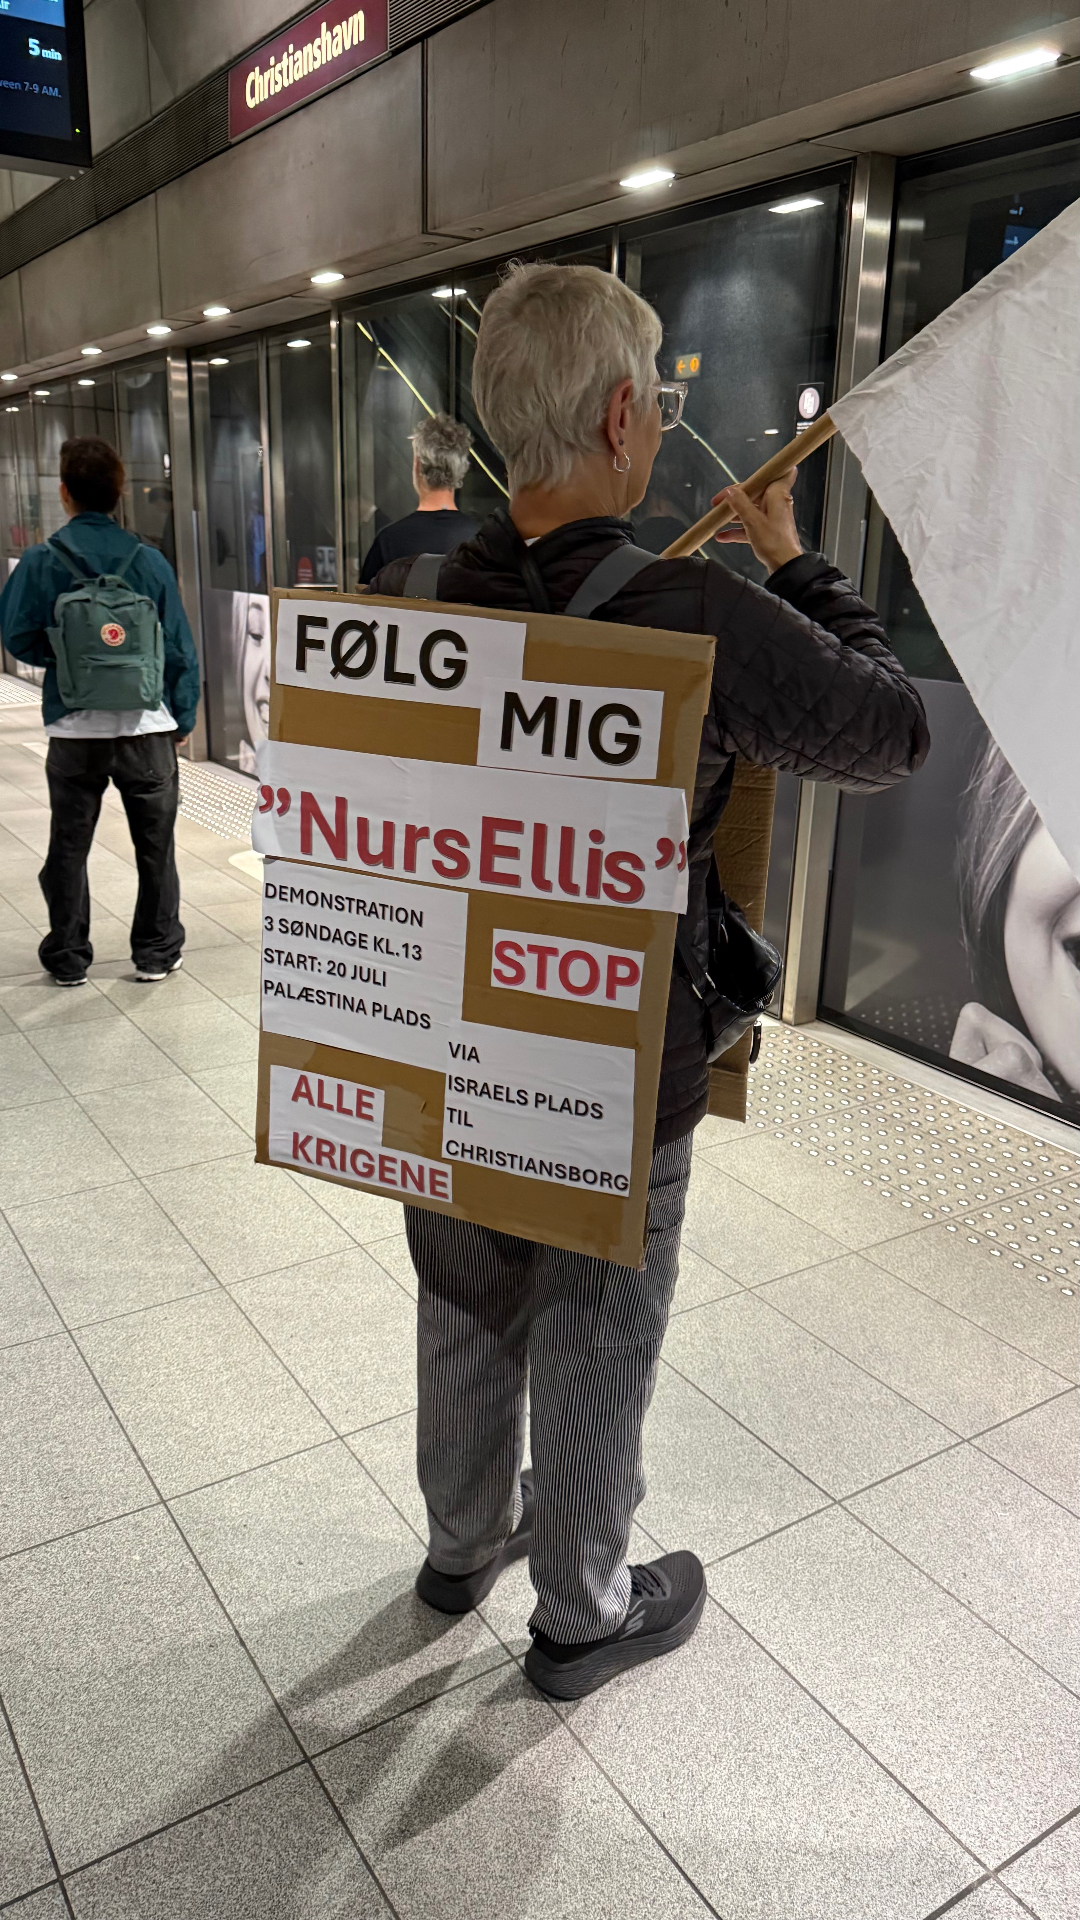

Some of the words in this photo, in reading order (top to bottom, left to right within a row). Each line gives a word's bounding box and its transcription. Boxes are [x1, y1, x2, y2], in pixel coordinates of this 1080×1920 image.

[28, 38, 40, 56] 5
[41, 48, 62, 61] min
[245, 9, 366, 109] Christianshavn
[23, 81, 39, 94] 7-9
[41, 86, 62, 98] AM.
[294, 614, 468, 691] FØLG
[500, 691, 642, 766] MIG
[264, 882, 424, 928] DEMONSTRATION
[264, 916, 274, 932] 3
[278, 918, 368, 949] SØNDAGE
[373, 936, 423, 961] KL.13
[263, 948, 322, 975] START:
[326, 959, 347, 978] 20
[350, 964, 387, 988] JULI
[492, 940, 641, 1001] STOP
[263, 980, 368, 1016] PALÆSTINA
[371, 1002, 432, 1030] PLADS
[448, 1041, 480, 1064] VIA
[291, 1074, 375, 1122] ALLE
[447, 1107, 474, 1129] TIL
[448, 1075, 529, 1107] ISRAELS
[534, 1092, 604, 1120] PLADS
[291, 1131, 450, 1200] KRIGENE
[445, 1140, 629, 1191] CHRISTIANSBORG
